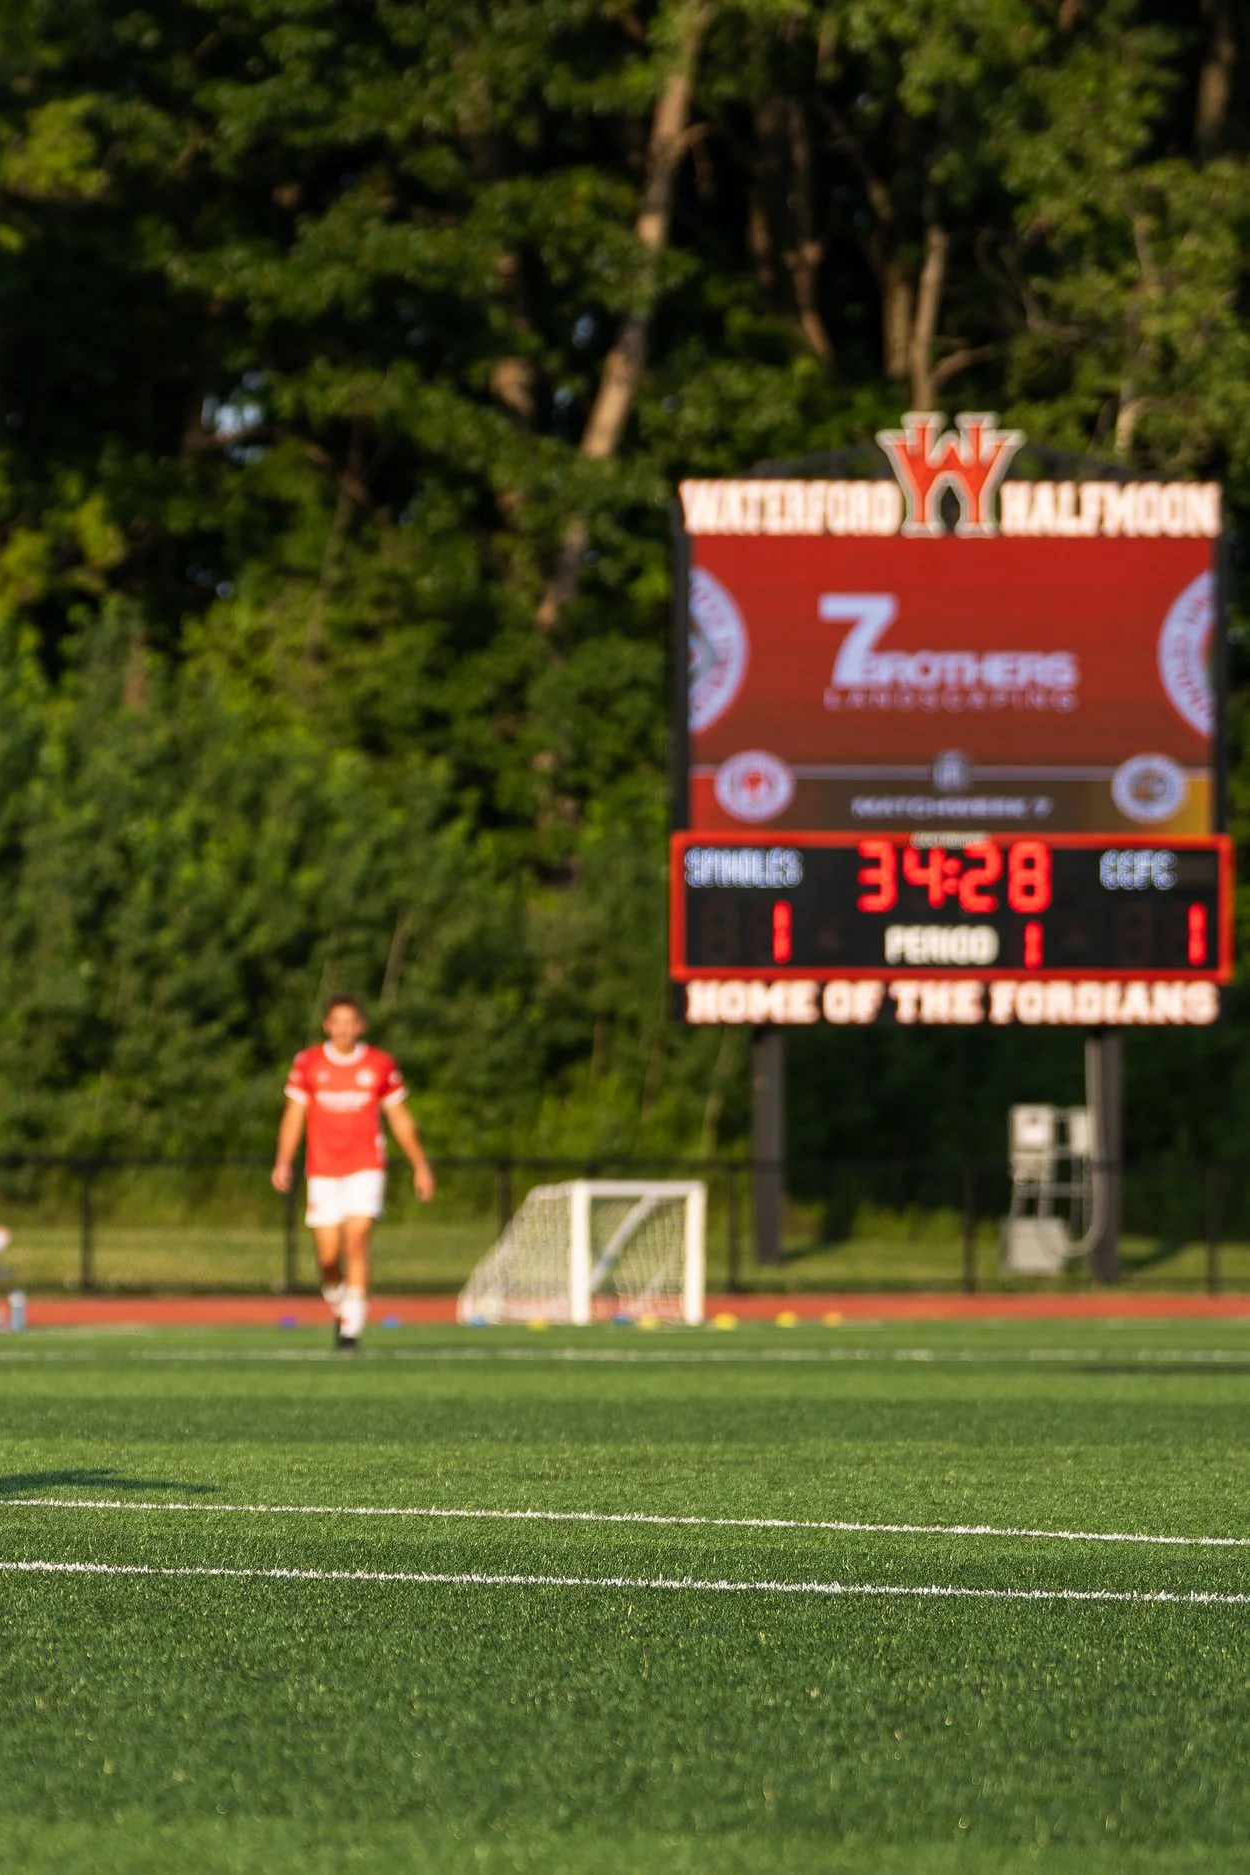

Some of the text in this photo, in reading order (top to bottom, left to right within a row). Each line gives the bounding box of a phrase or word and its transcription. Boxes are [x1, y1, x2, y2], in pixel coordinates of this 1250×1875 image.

[679, 478, 1222, 536] WATERFORD HALFMOON
[857, 839, 1051, 913] 34:28
[772, 901, 792, 965] 1
[884, 924, 1000, 965] PERIOD
[1024, 921, 1044, 970] 1
[1187, 903, 1207, 966] 1
[686, 979, 1220, 1024] HOME OF THE FORDIANS
